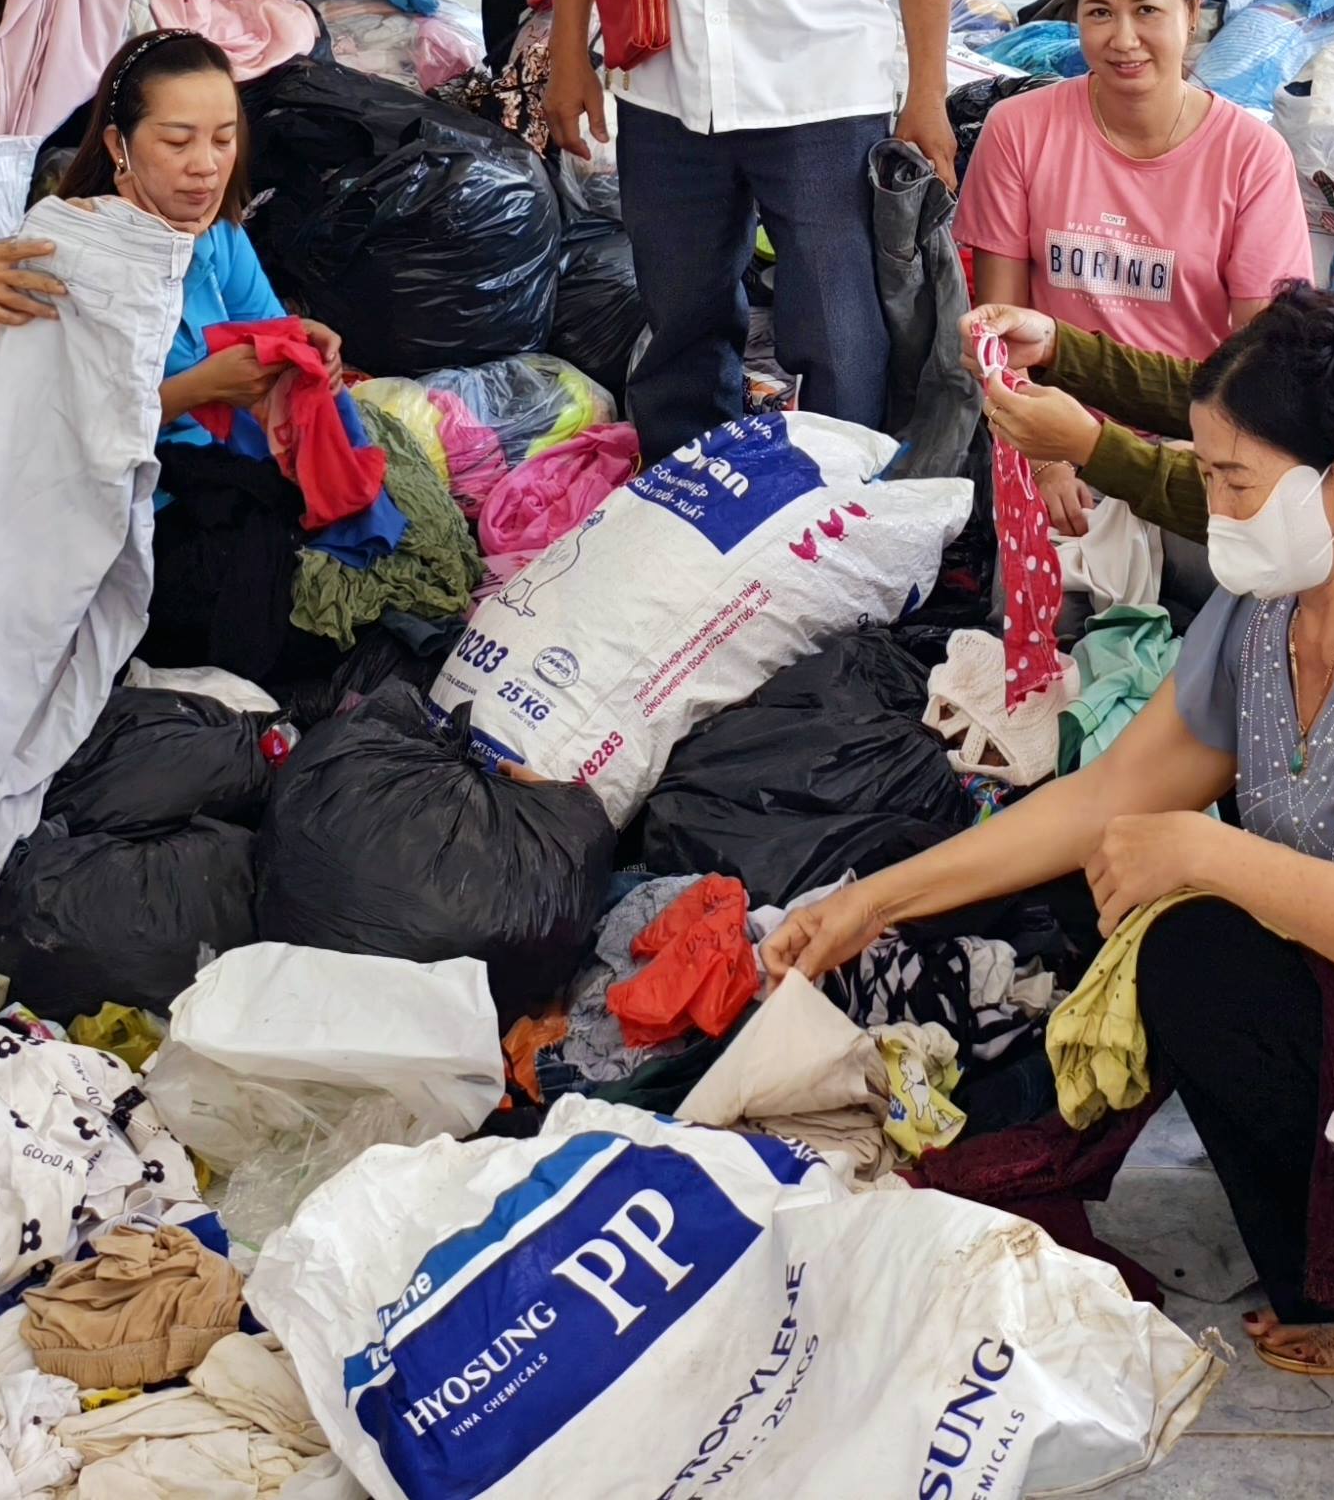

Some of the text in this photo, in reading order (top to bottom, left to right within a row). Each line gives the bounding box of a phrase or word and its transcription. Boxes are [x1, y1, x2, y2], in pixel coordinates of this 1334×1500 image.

[1049, 243, 1166, 290] BORING
[1067, 221, 1102, 235] MAKE
[1124, 231, 1155, 246] FEEL
[673, 497, 707, 522] XUẤT
[633, 681, 654, 703] THỨC
[680, 634, 702, 655] HOÀN
[716, 604, 734, 621] CHO
[730, 595, 743, 609] GÀ
[739, 579, 762, 601] TRẮNG
[642, 695, 663, 718] CÔNG
[687, 647, 710, 671] ĐOẠN
[722, 618, 741, 638] NGÀY
[737, 603, 757, 624] TUỔI
[496, 680, 525, 704] 25
[519, 694, 552, 722] KG
[571, 730, 625, 788] V8283
[22, 1142, 62, 1169] GOOD
[550, 1187, 696, 1337] PP
[401, 1299, 559, 1438] HYOSUNG
[450, 1351, 550, 1438] VINA CHEMICALS
[760, 1333, 820, 1429] 25KGS
